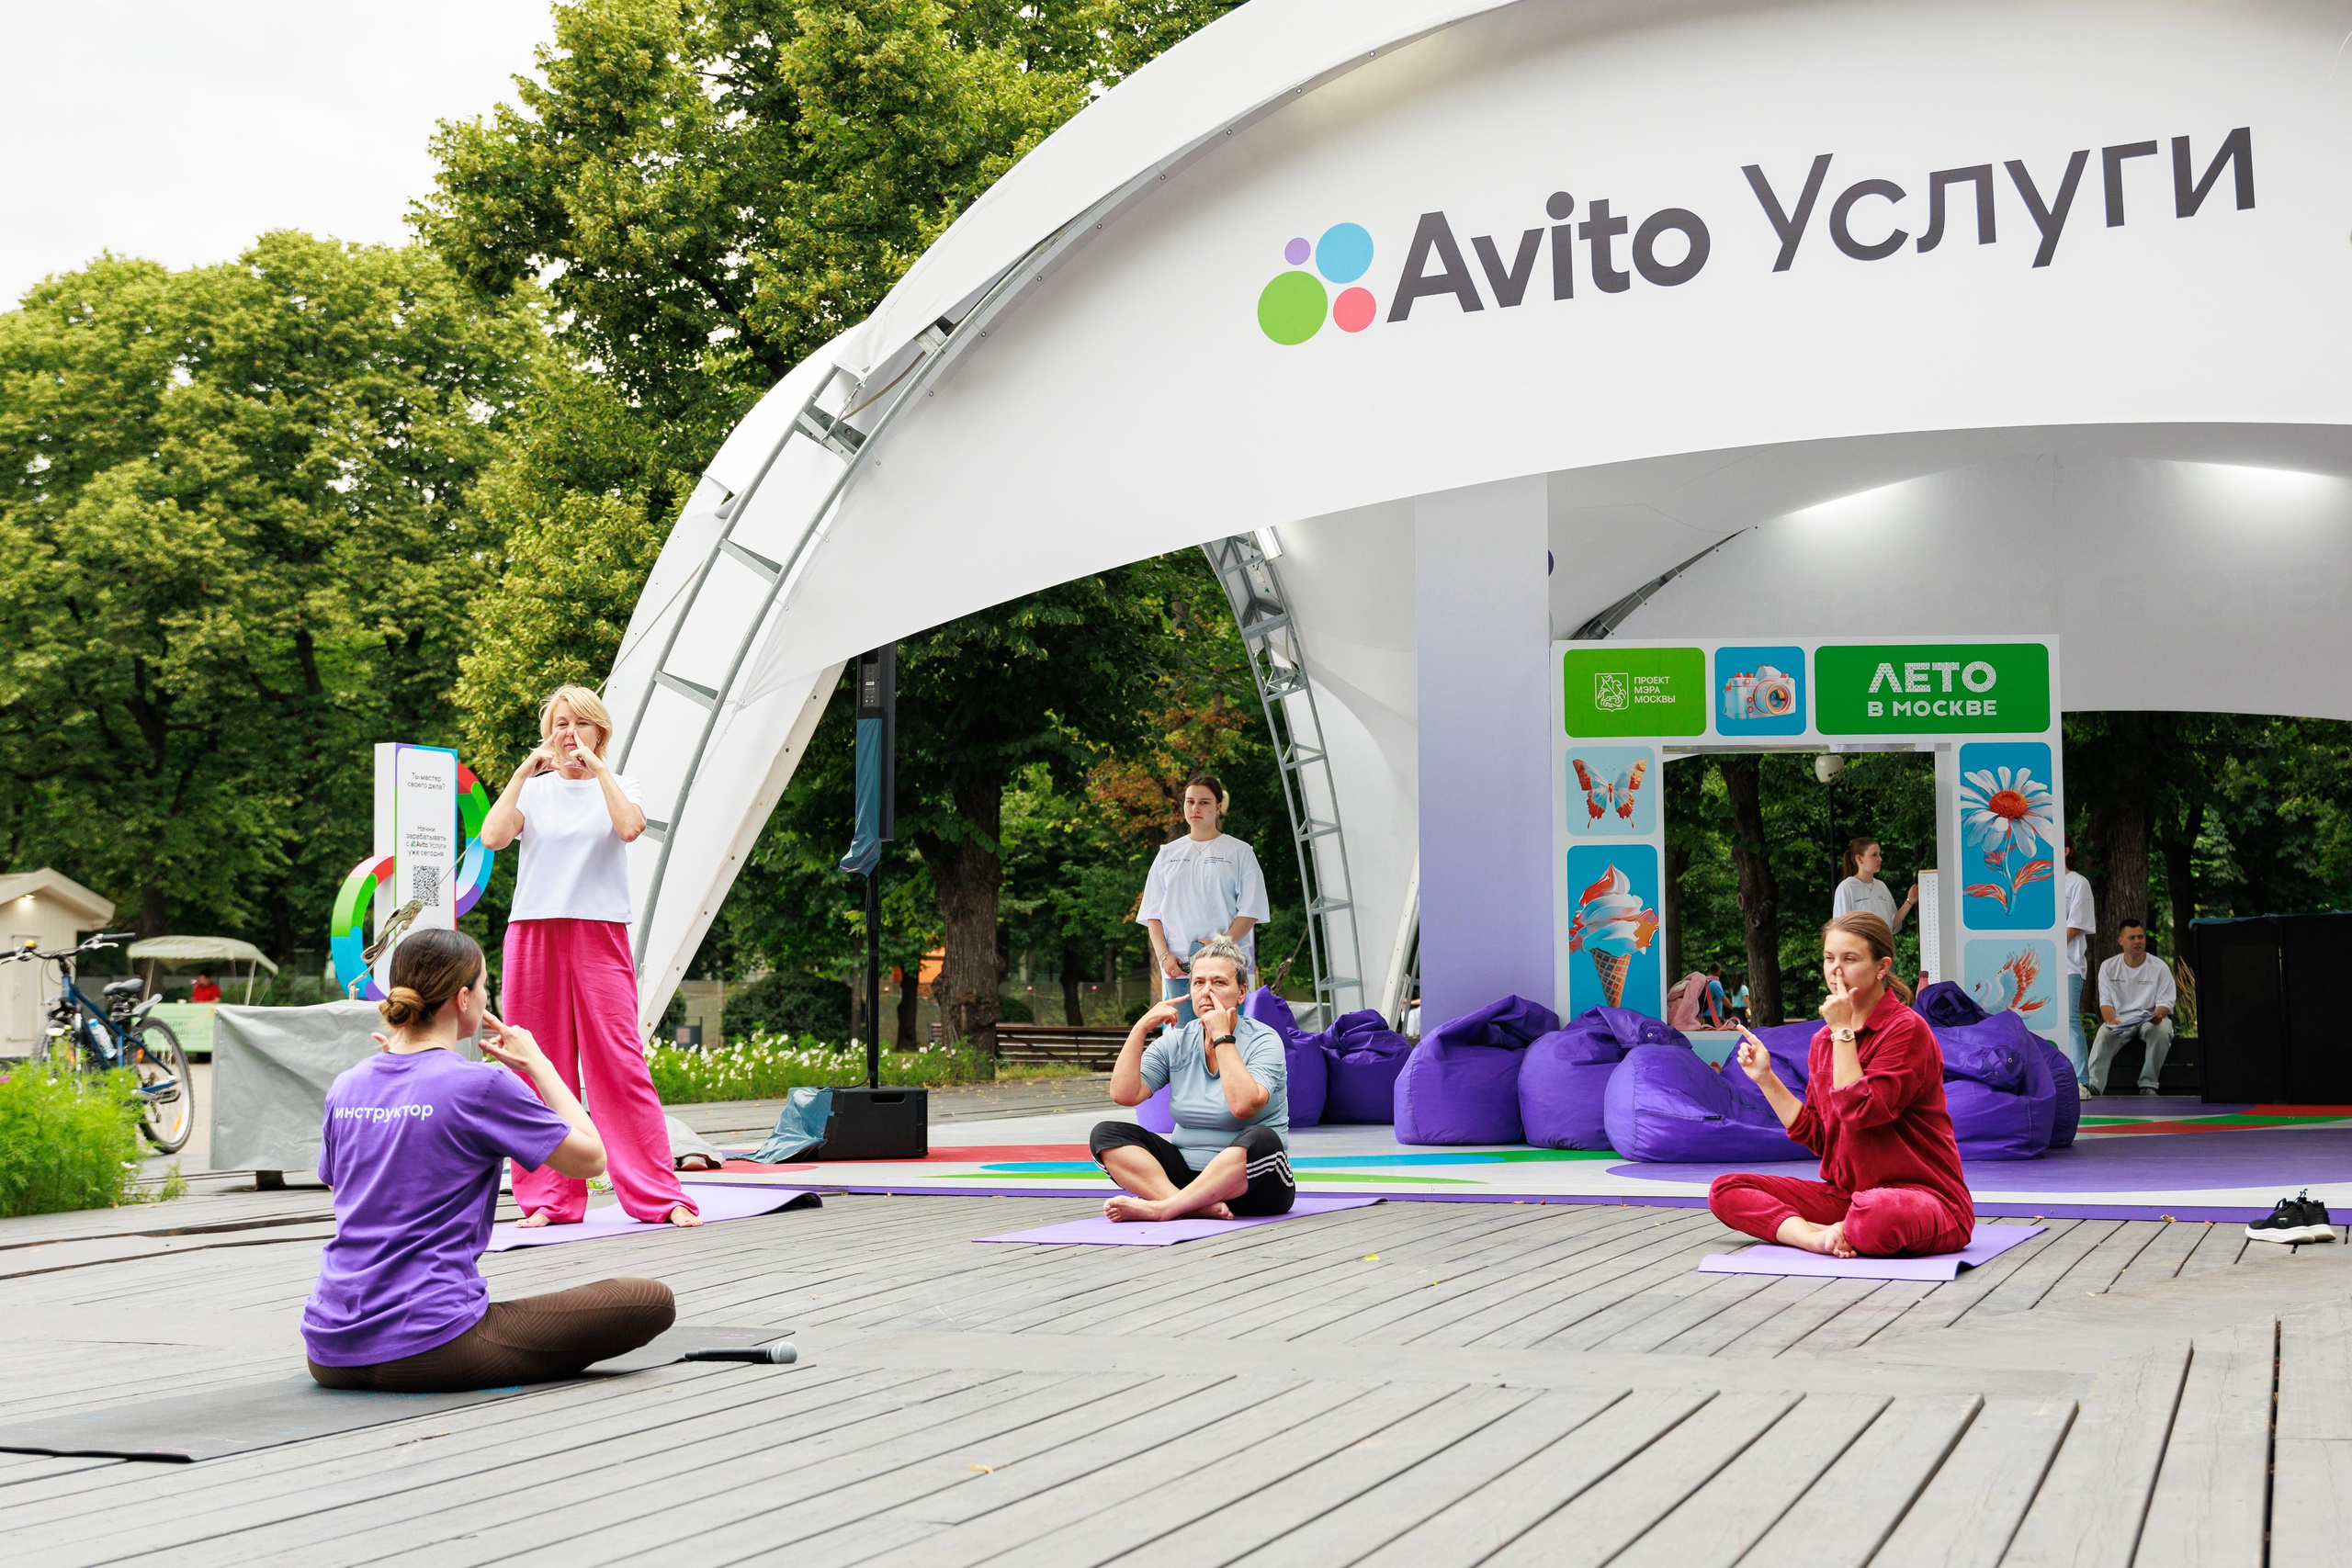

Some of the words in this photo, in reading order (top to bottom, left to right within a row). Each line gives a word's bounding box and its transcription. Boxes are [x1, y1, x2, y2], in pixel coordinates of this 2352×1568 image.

[1386, 190, 1711, 323] Avito
[1740, 126, 2256, 273] Услуги
[1634, 676, 1670, 684] ПРОЕКТ
[1868, 660, 1997, 694] ЛЕТО
[1634, 685, 1661, 694] МЭРА
[1634, 695, 1676, 704] МОСКВЫ
[1868, 701, 1883, 717] В
[1893, 700, 1997, 716] МОСКВЕ
[407, 781, 428, 789] своего
[334, 1104, 434, 1123] инструктор
